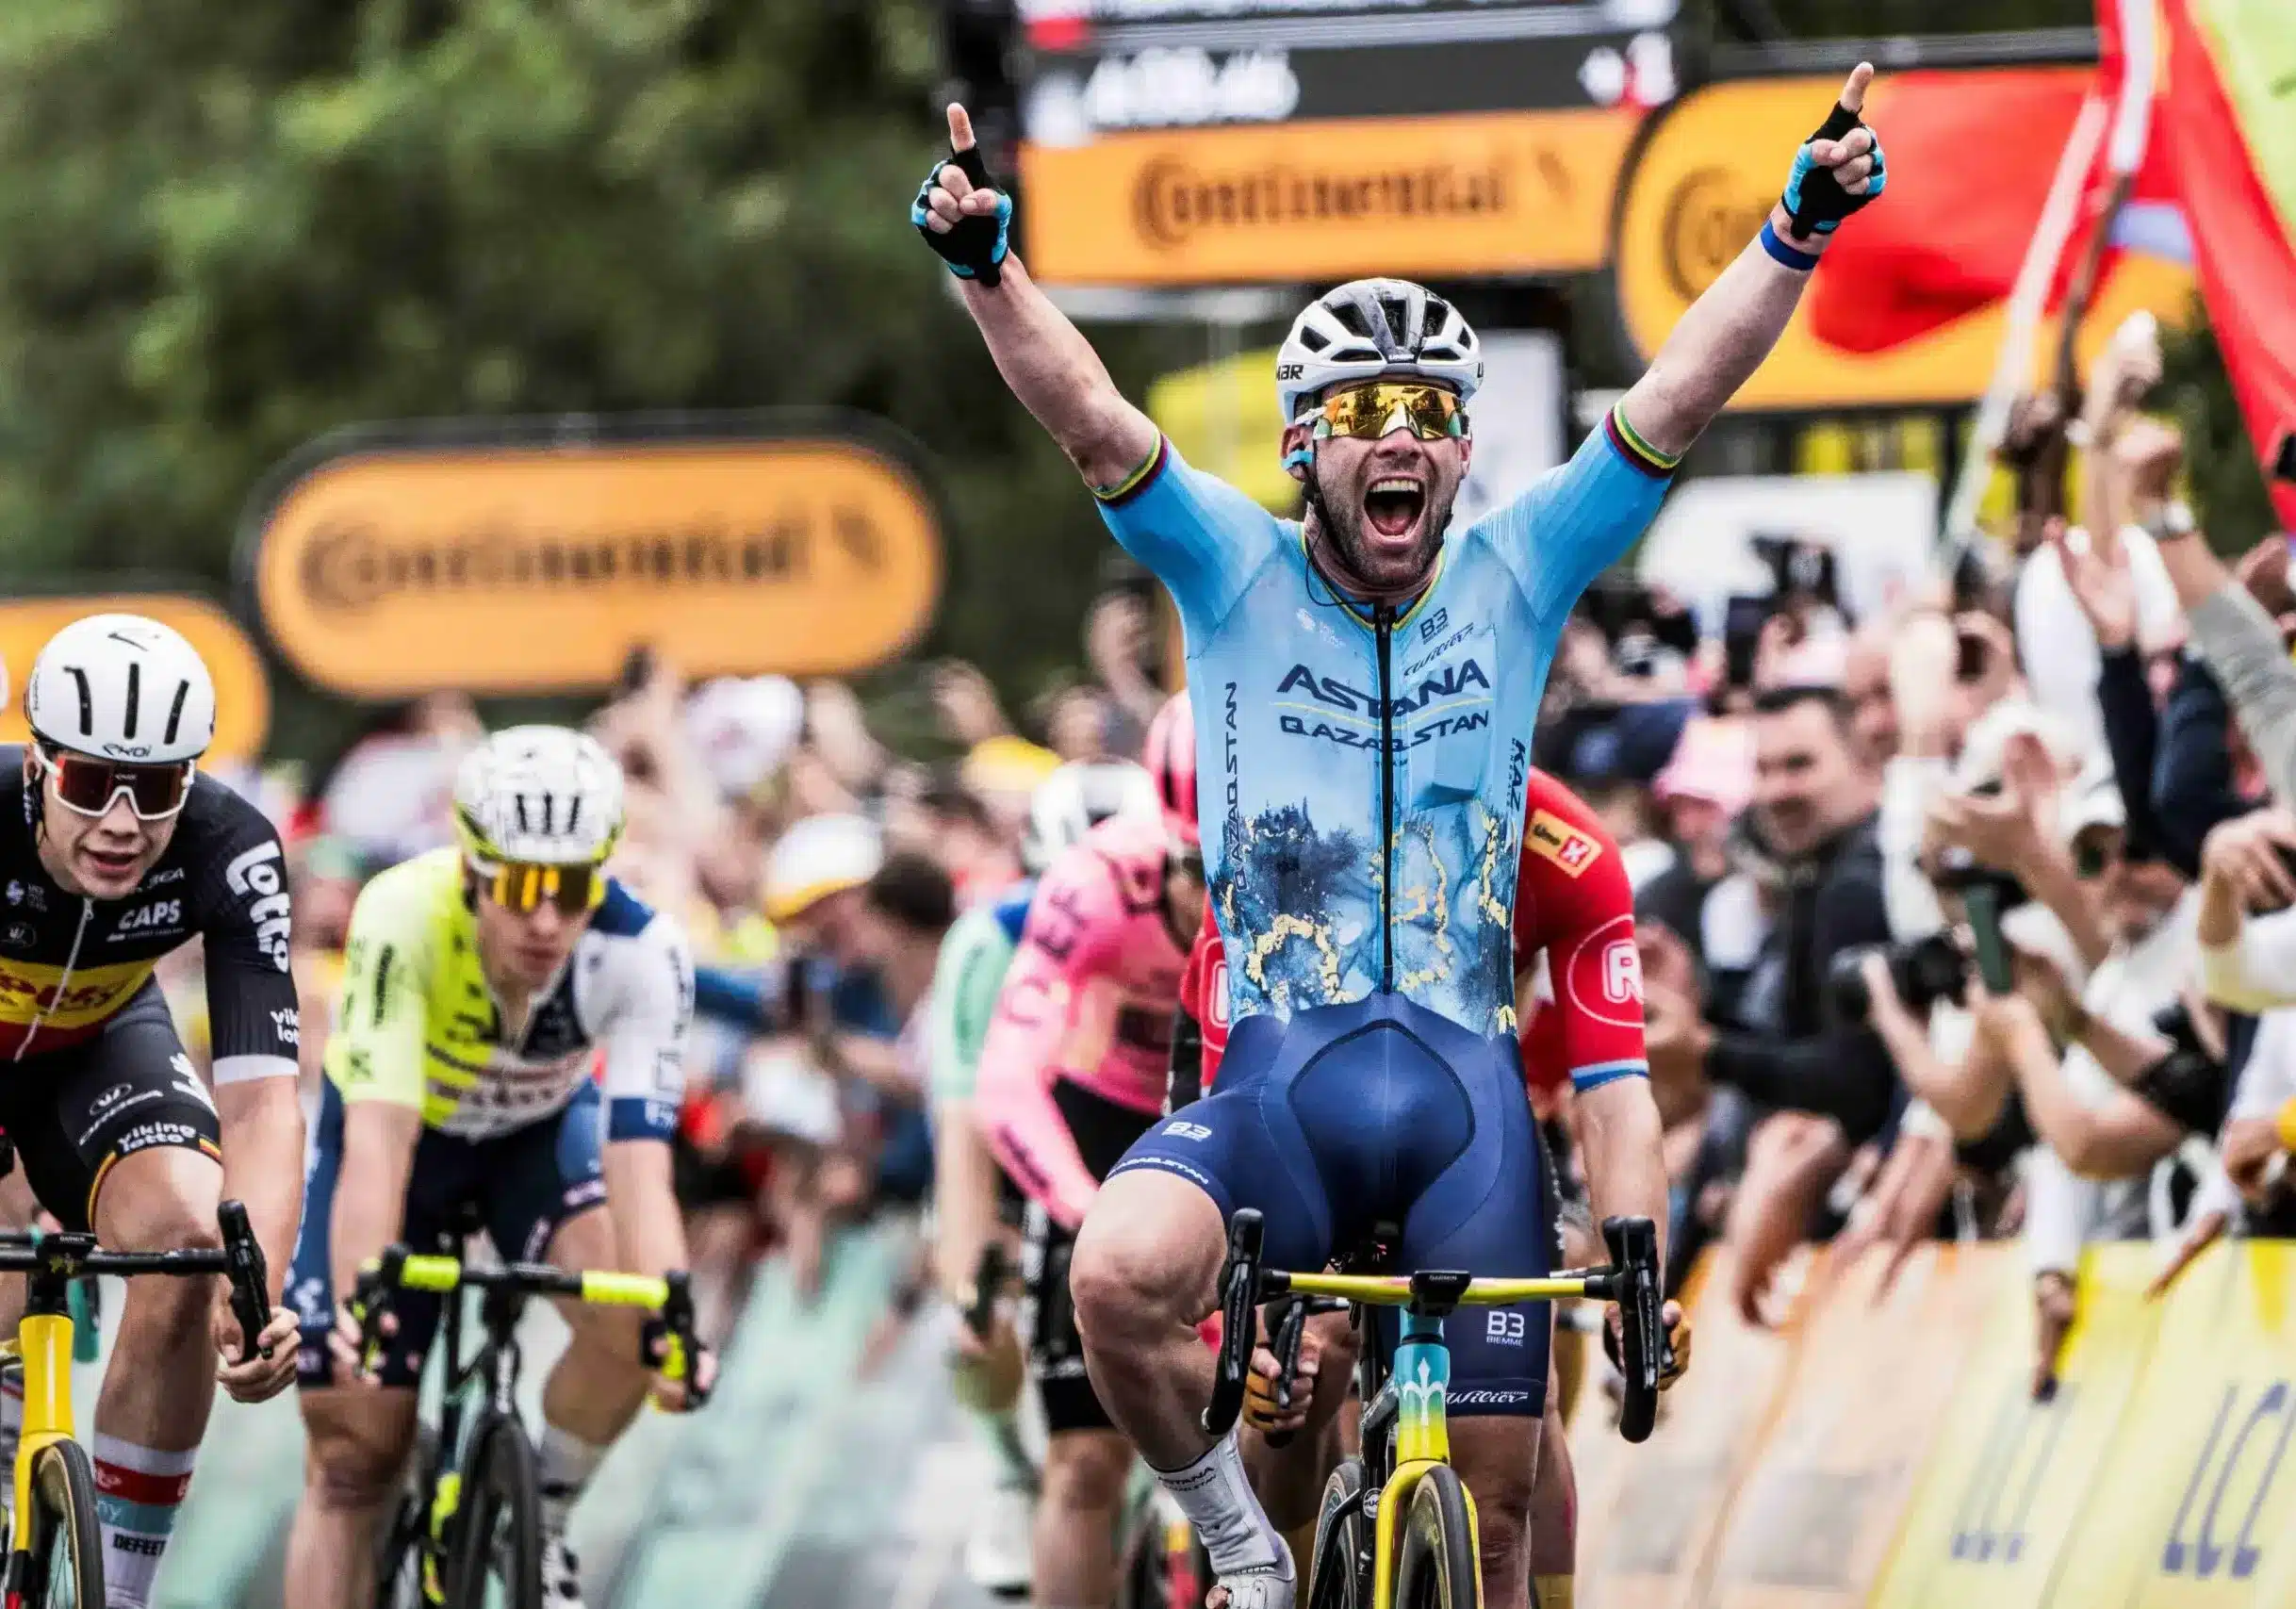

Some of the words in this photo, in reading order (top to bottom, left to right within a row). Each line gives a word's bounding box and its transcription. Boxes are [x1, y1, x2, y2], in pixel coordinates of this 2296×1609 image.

[1275, 659, 1491, 720] ASTANA
[1225, 681, 1248, 892] QAZAQSTAN
[118, 898, 182, 930] CAPS
[1486, 1310, 1525, 1338] B3
[1486, 1336, 1524, 1347] BIEMME
